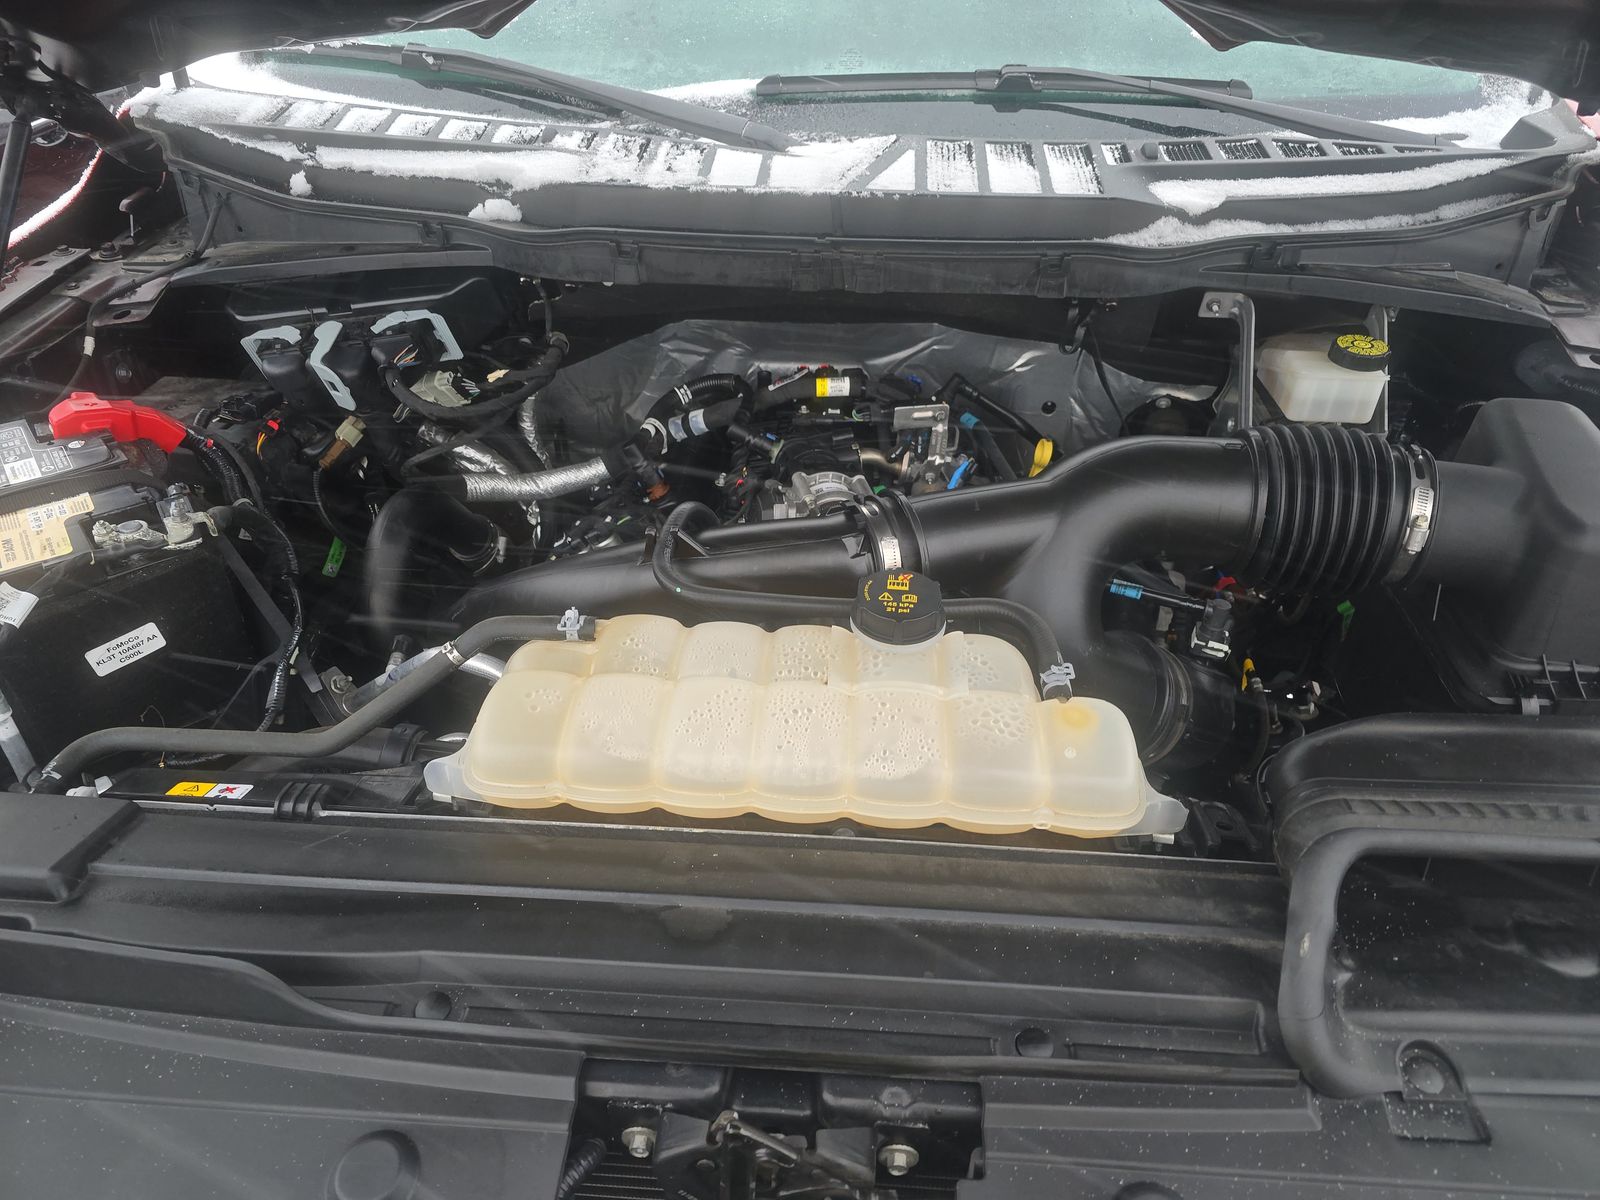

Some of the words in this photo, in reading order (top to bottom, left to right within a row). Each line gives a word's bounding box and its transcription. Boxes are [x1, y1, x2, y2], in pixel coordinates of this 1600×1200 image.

[95, 653, 117, 667] KL3T
[118, 639, 145, 656] 10A687
[146, 634, 158, 643] AA
[107, 635, 140, 653] FoMoCo
[119, 649, 144, 663] C500L
